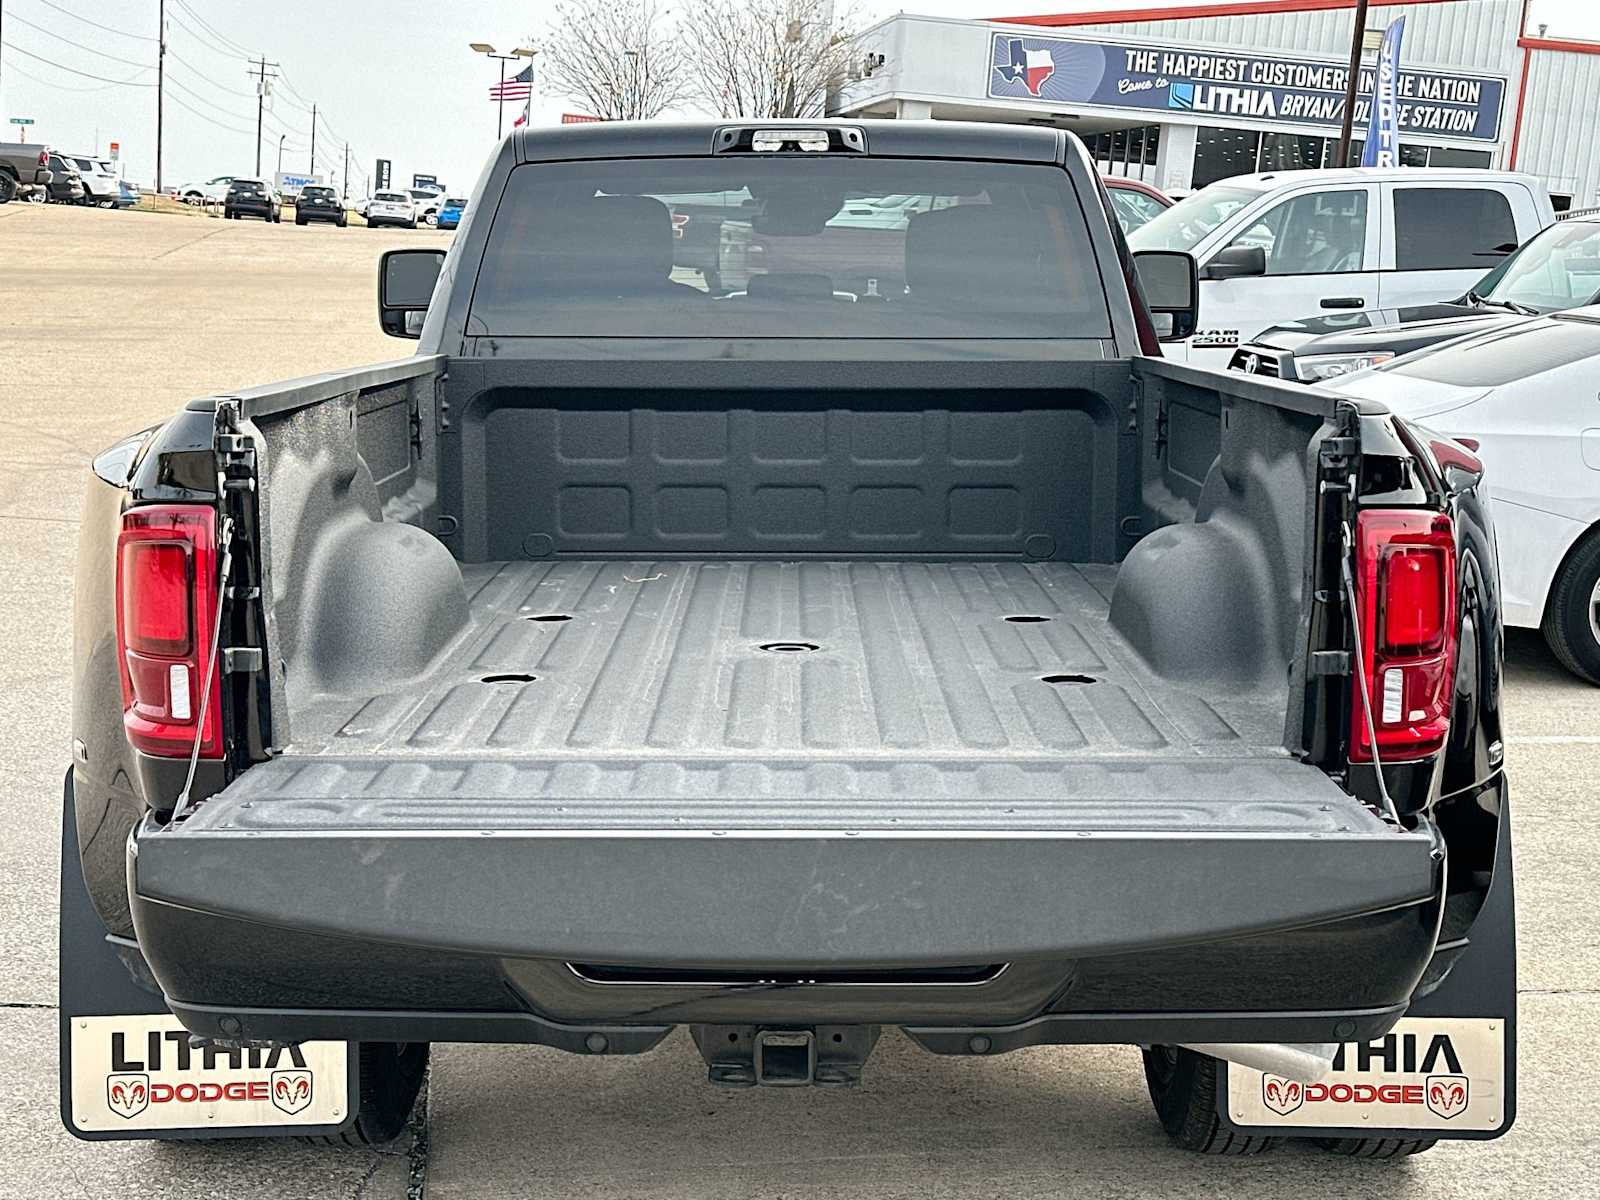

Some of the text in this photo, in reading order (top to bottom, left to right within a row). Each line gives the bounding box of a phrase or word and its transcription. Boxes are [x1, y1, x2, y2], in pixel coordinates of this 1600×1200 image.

[1118, 77, 1169, 94] Come to
[1125, 50, 1158, 73] THE
[1162, 53, 1249, 81] HAPPIEST
[1359, 71, 1376, 92] IN
[1397, 74, 1415, 96] HE
[1418, 76, 1481, 103] NATION
[1192, 85, 1276, 117] LITHIA
[1411, 105, 1478, 132] STATION
[1332, 1034, 1463, 1074] HIA
[151, 1082, 269, 1103] DODGE
[1305, 1083, 1424, 1105] DODGE
